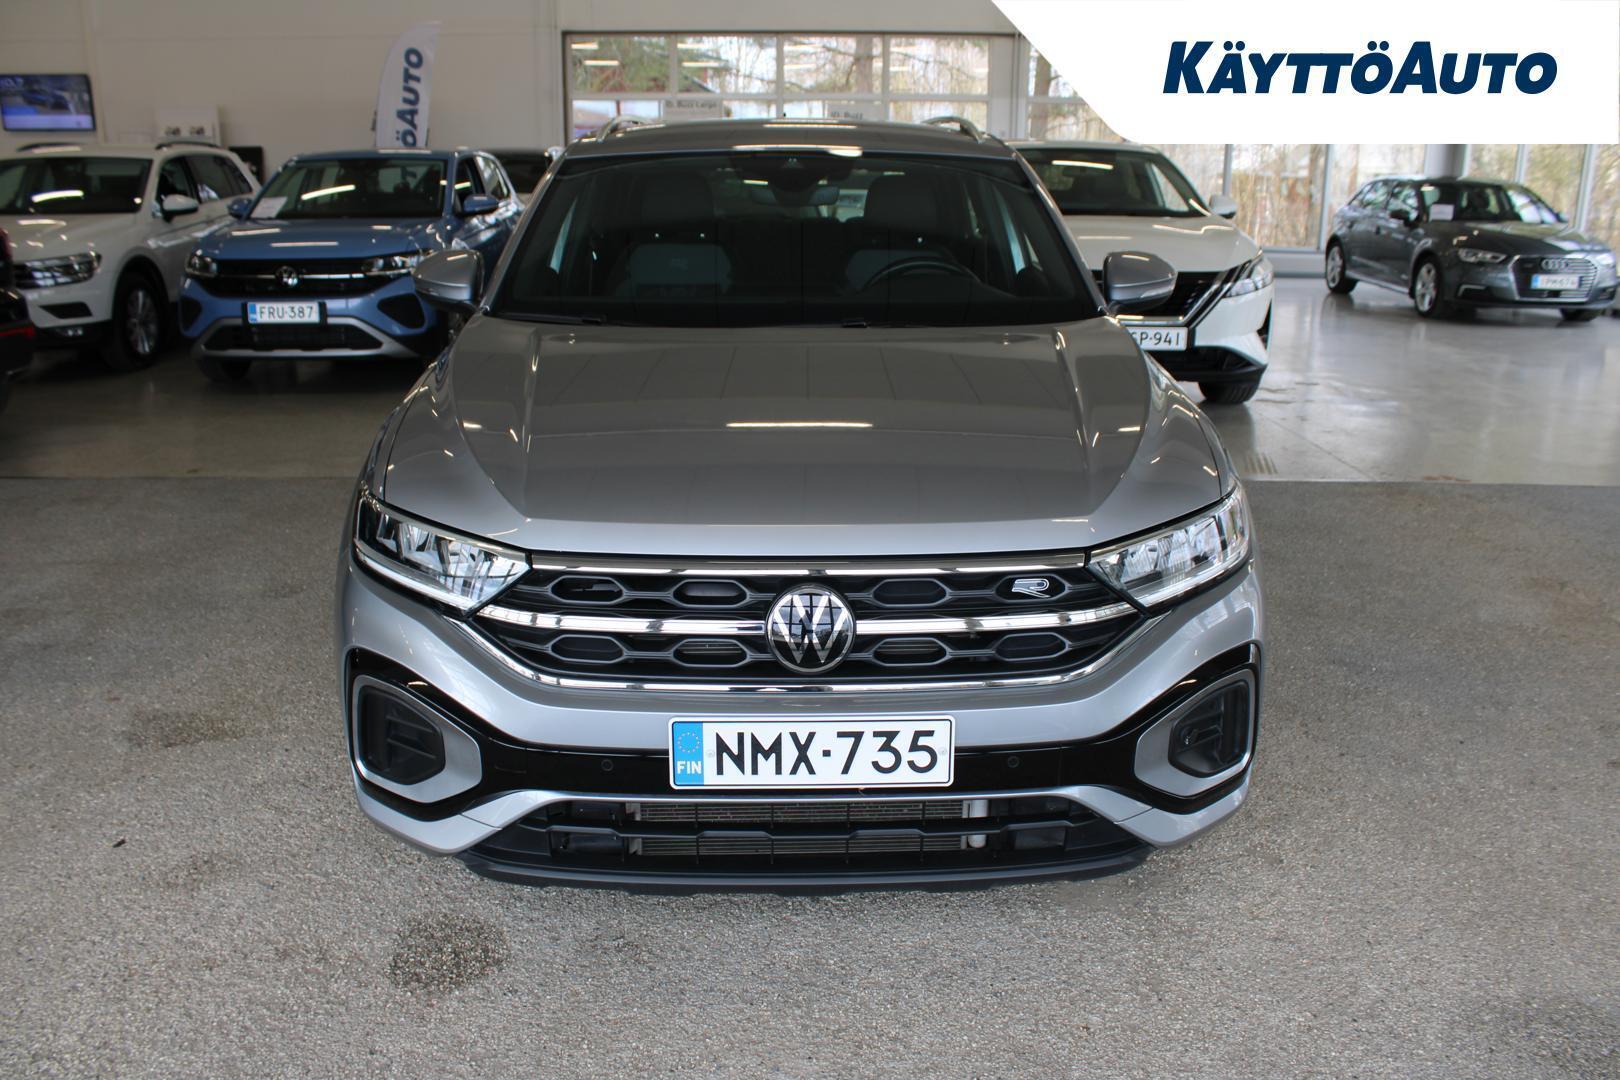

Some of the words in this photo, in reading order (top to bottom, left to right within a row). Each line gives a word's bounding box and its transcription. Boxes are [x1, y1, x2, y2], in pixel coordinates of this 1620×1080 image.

[259, 305, 314, 319] FRU-387
[1130, 331, 1180, 346] P-941
[676, 760, 702, 775] FIN
[715, 729, 939, 776] NMX-735
